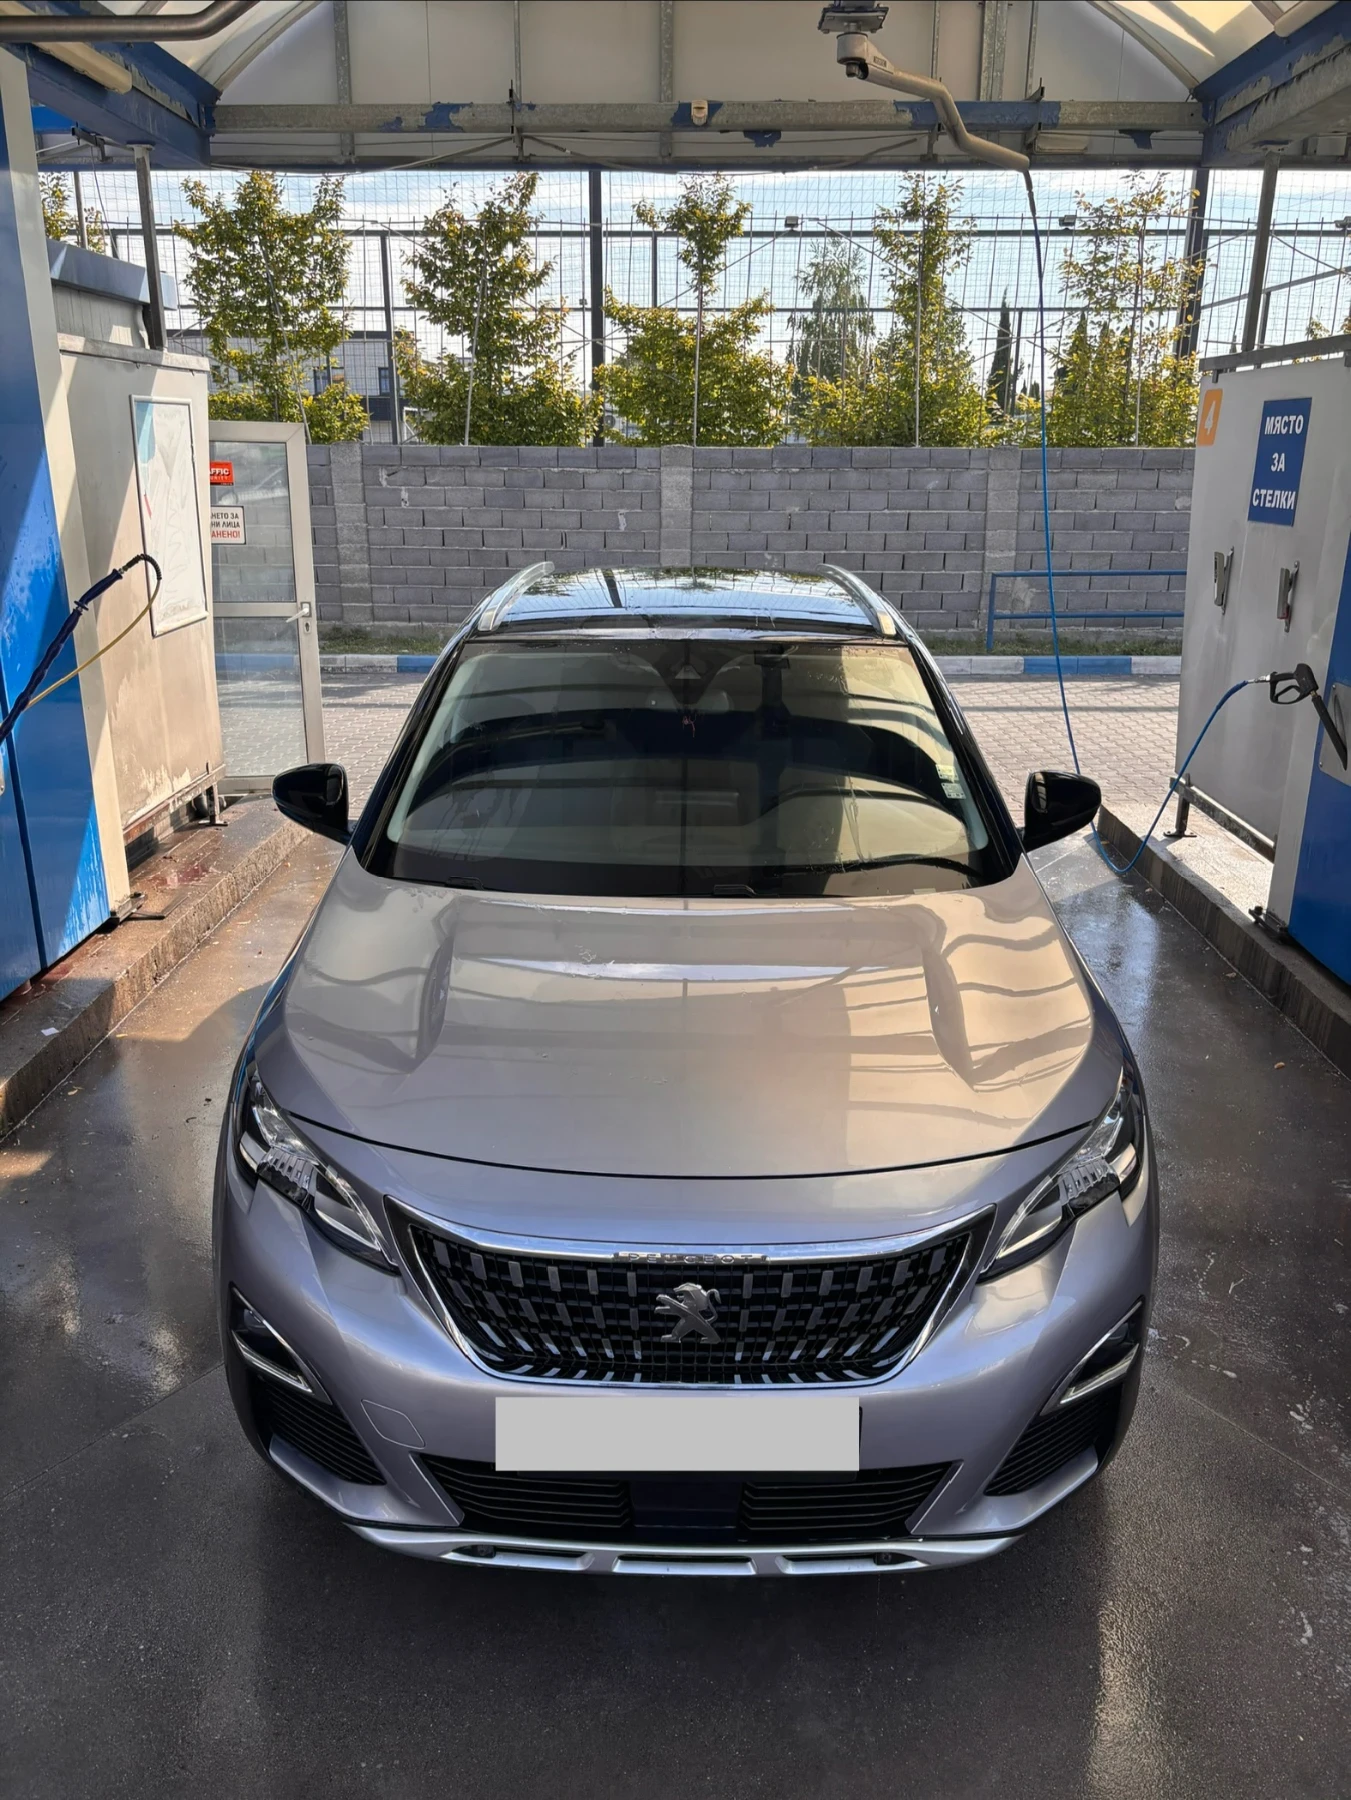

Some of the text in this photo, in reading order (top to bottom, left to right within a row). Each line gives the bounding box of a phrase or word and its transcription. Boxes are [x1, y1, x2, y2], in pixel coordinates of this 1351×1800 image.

[1204, 401, 1215, 435] 4
[1264, 415, 1304, 434] МЯСТО
[1271, 453, 1285, 472] ЗА
[1252, 489, 1296, 509] СТЕЛКИ
[628, 1252, 753, 1264] PEUGEOT
